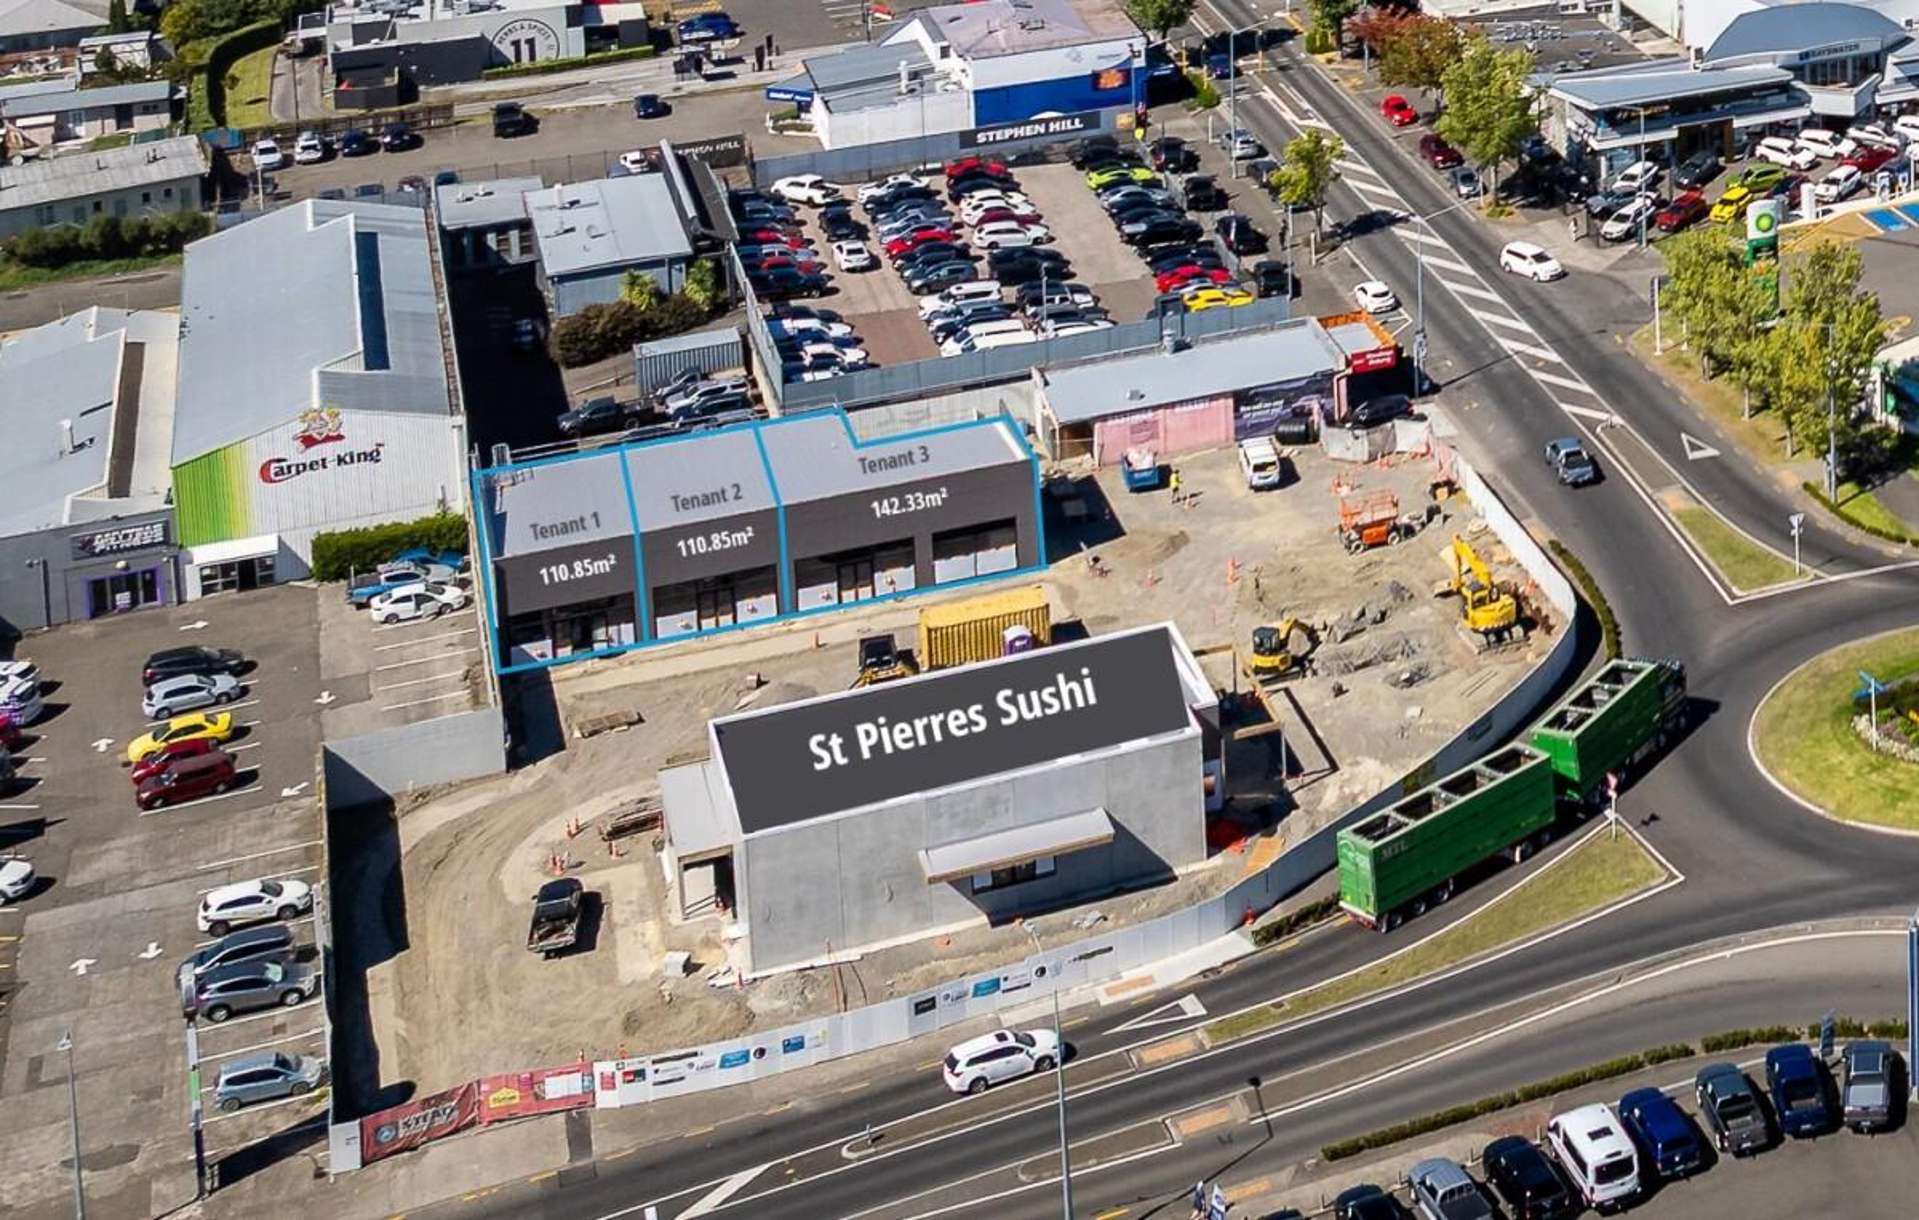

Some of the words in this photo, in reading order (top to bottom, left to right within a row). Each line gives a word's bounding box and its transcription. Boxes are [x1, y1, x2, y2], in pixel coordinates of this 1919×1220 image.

[510, 37, 536, 63] 11
[976, 123, 1046, 143] STEPHEN
[1048, 118, 1084, 132] HILL
[259, 456, 328, 483] Carpet
[336, 447, 381, 464] King
